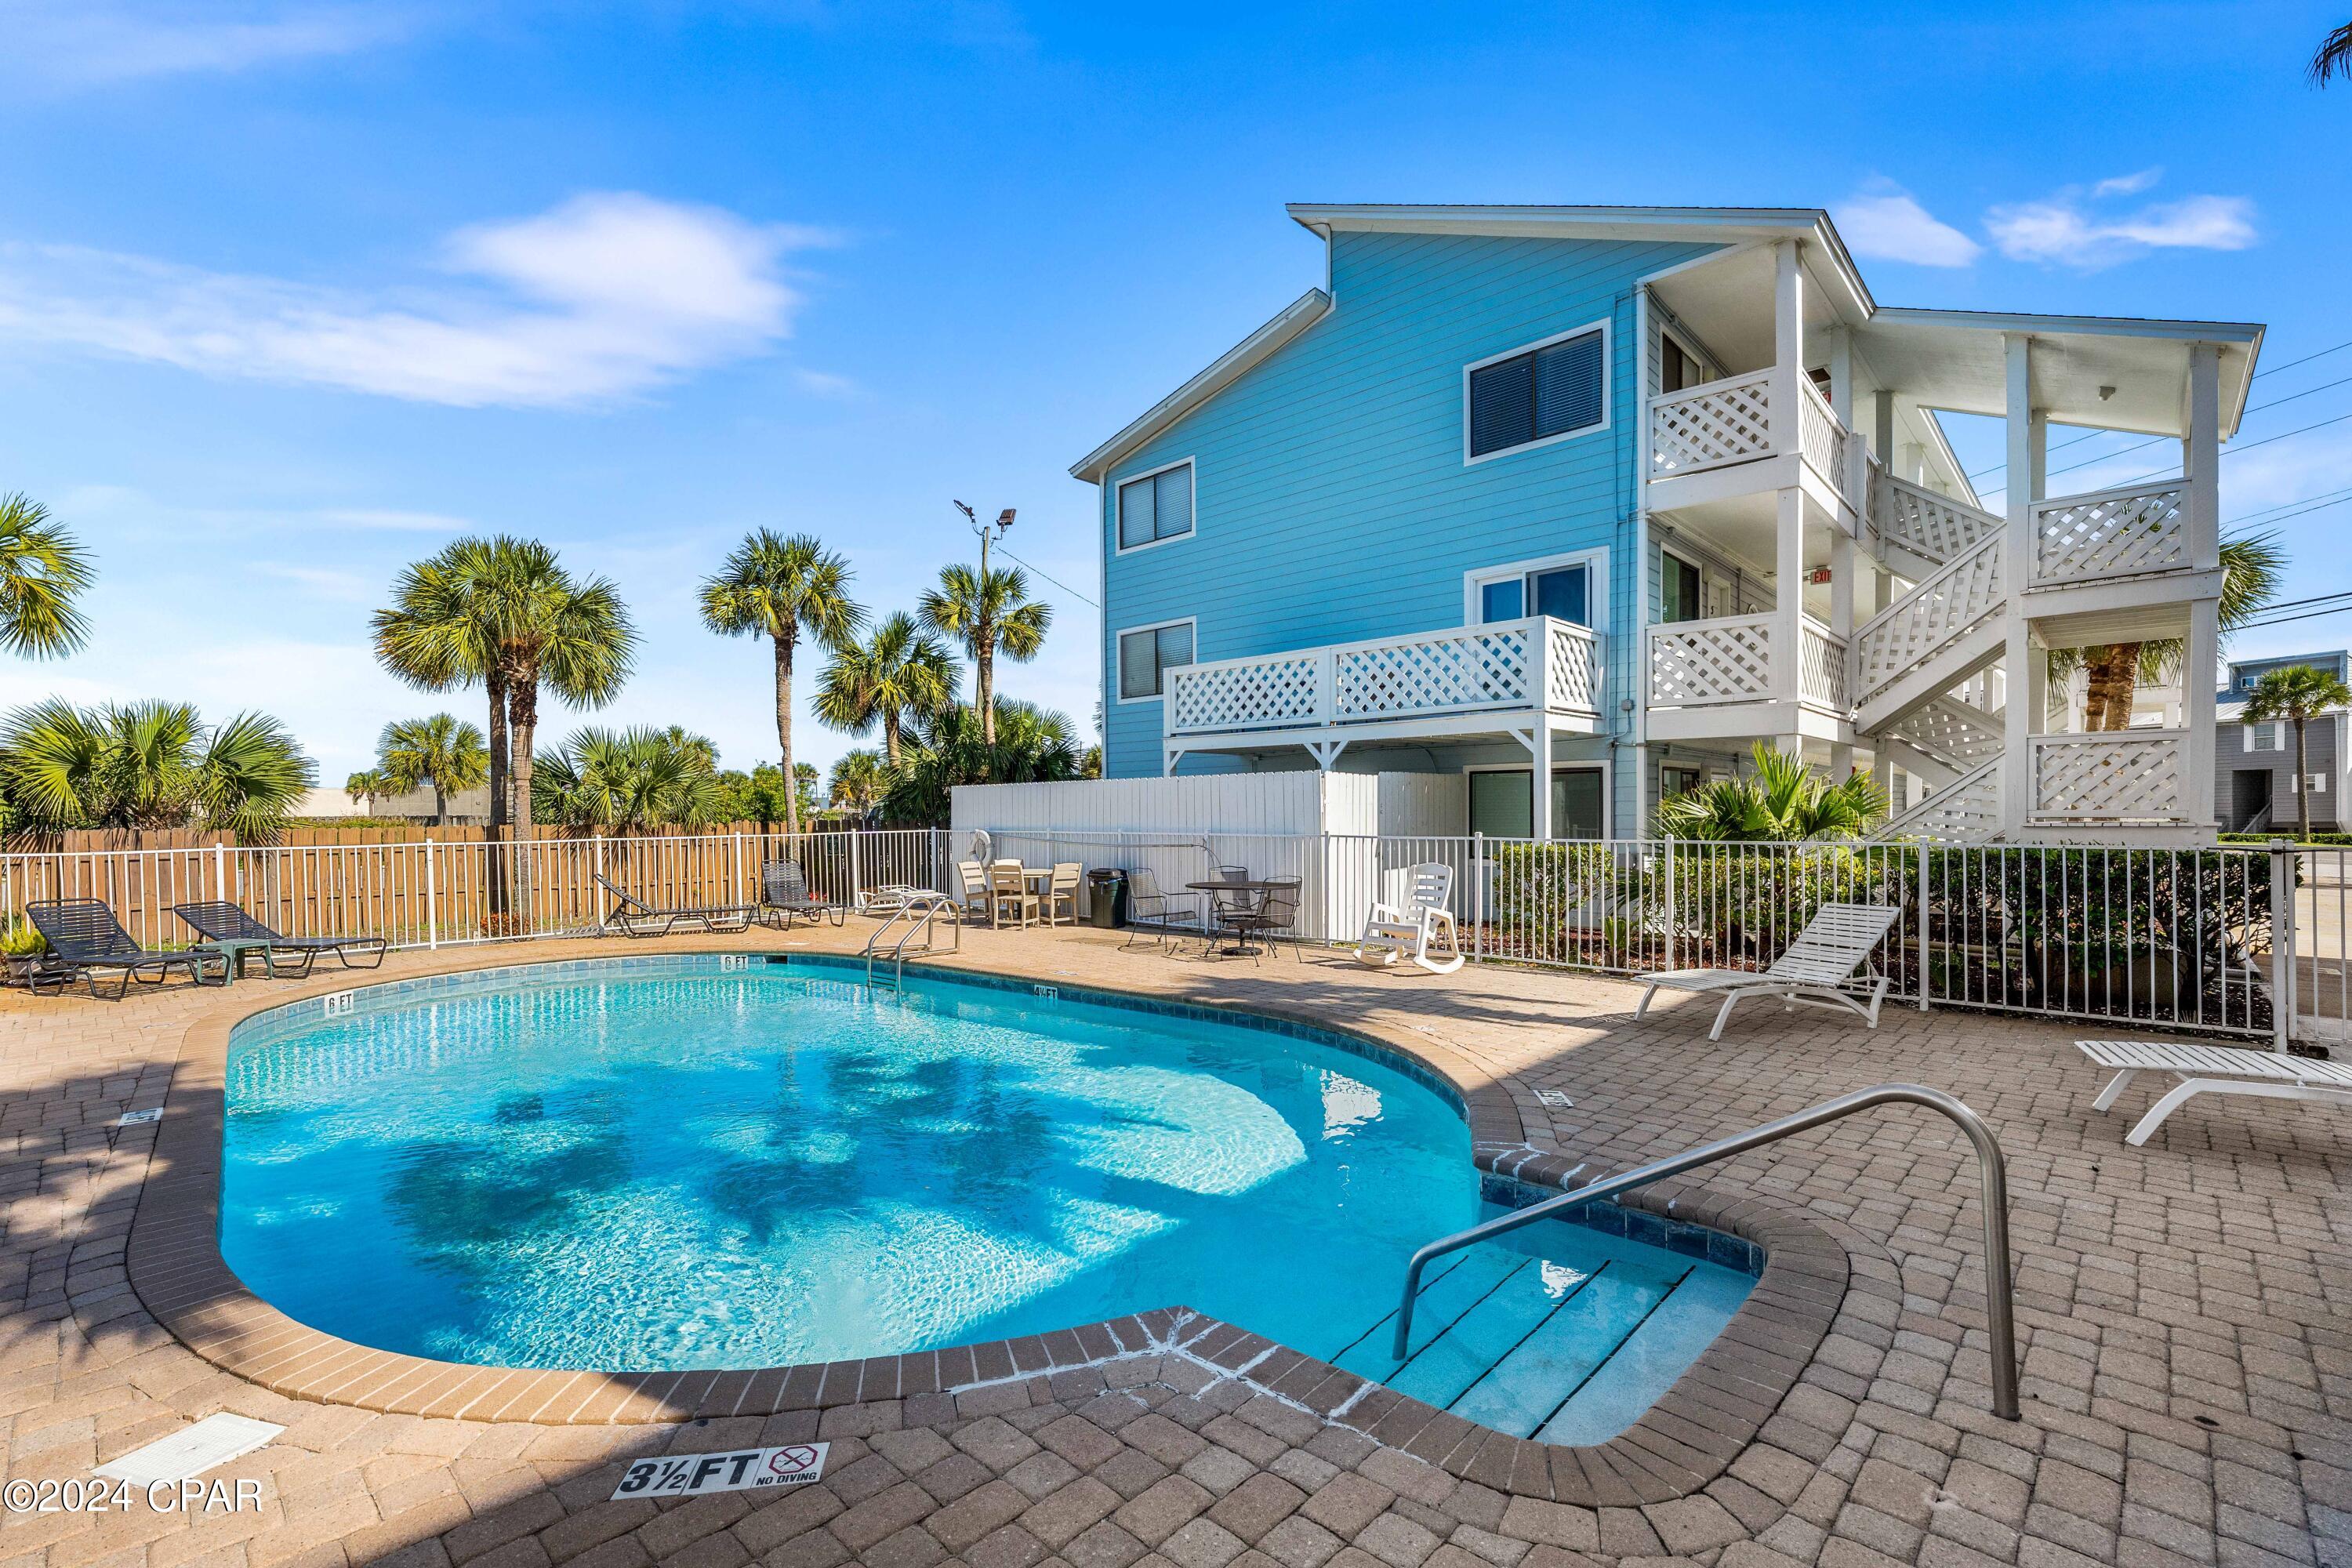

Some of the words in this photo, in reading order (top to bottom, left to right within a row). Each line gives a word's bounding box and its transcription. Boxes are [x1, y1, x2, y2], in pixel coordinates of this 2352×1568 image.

[1814, 570, 1831, 583] EXIT
[756, 1476, 774, 1486] NO
[777, 1472, 817, 1483] DIVING
